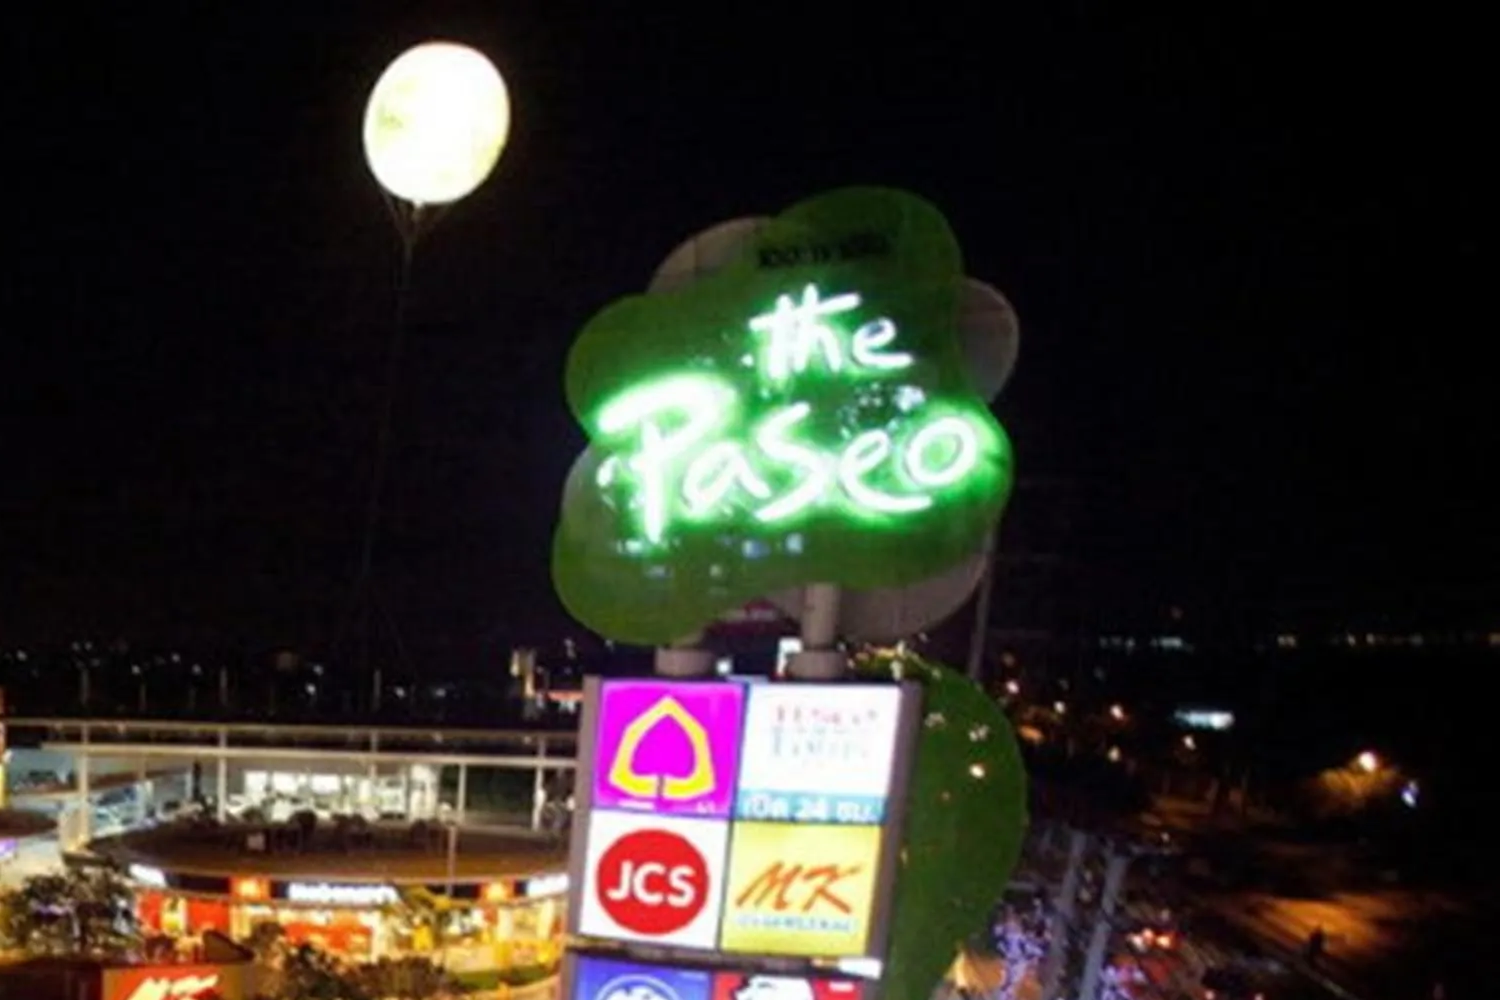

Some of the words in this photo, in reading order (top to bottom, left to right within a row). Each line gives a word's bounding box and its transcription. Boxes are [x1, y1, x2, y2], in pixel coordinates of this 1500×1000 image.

[748, 282, 914, 388] the
[606, 860, 697, 908] JCS
[735, 861, 861, 914] MK
